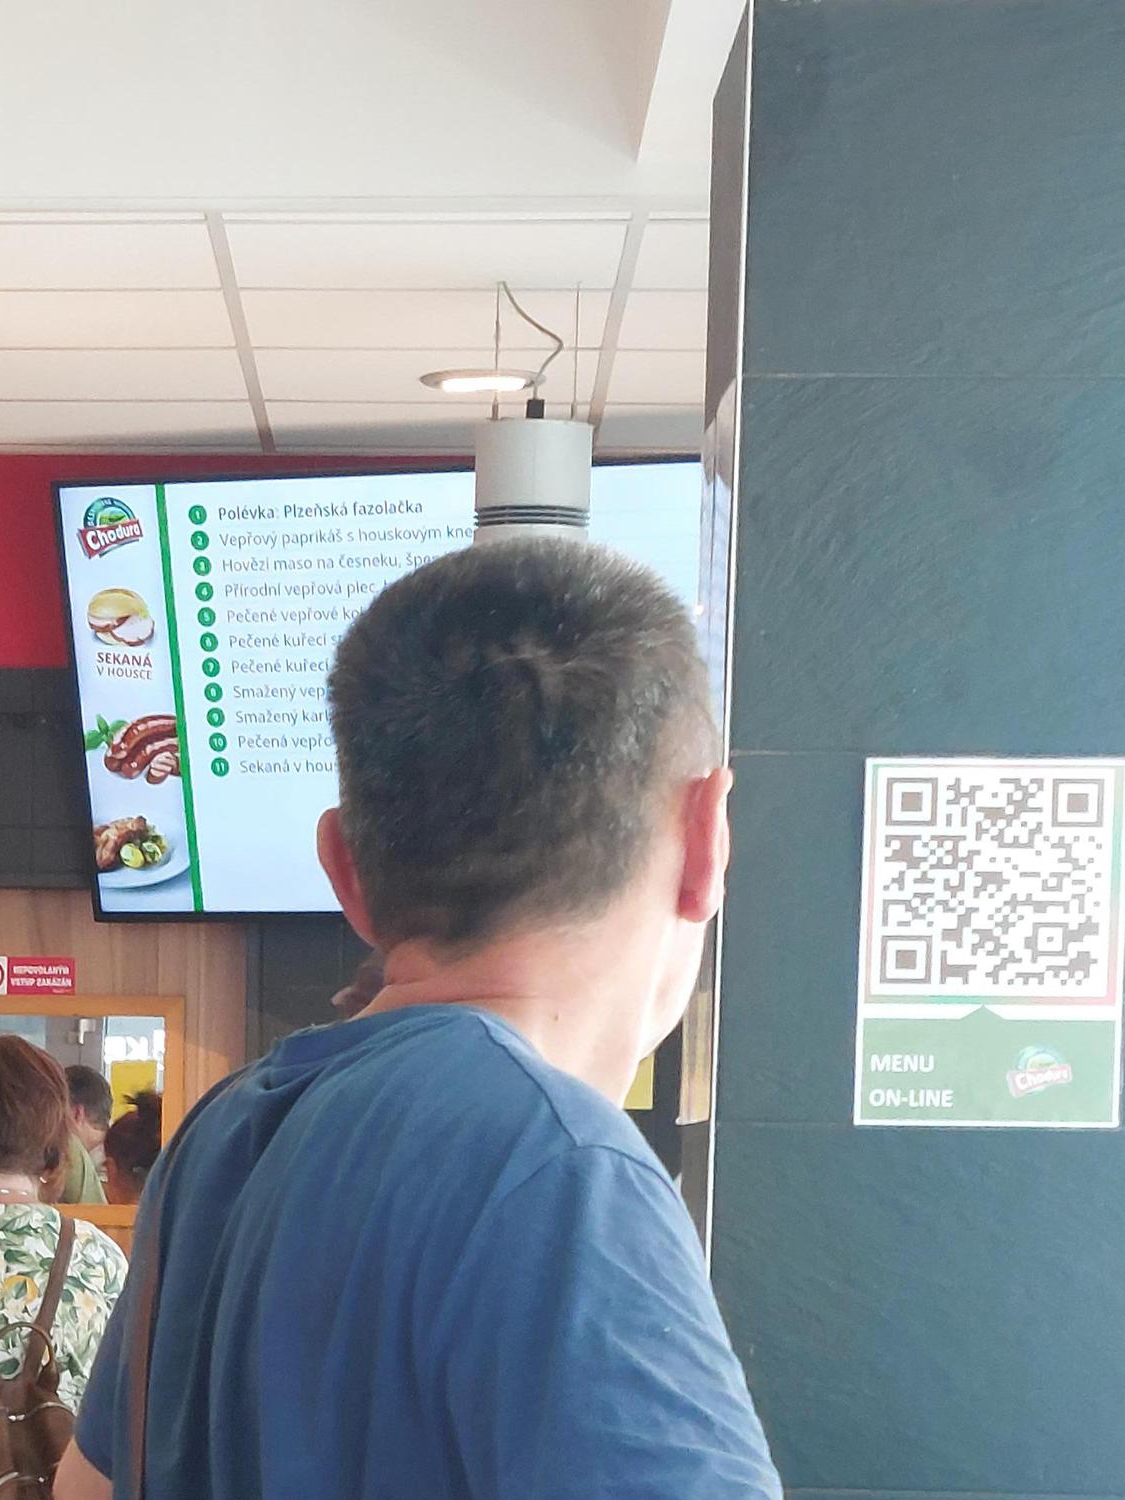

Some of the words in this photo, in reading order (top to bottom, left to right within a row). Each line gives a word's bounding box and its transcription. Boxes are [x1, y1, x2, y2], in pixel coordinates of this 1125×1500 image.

[284, 502, 348, 519] Plzeňská
[353, 500, 423, 517] fazolačka
[86, 522, 141, 550] Chodura
[219, 531, 277, 550] Vepřový
[282, 528, 343, 549] paprikáš
[347, 531, 354, 542] s
[359, 527, 442, 544] houskovým
[446, 525, 473, 539] kne
[222, 556, 270, 572] Hovězí
[274, 558, 313, 571] maso
[317, 557, 335, 569] na
[339, 553, 401, 569] česneku,
[224, 581, 281, 598] Přírodní
[284, 579, 342, 599] vepřová
[227, 607, 277, 623] Pečené
[281, 606, 339, 625] vepřové
[229, 632, 279, 648] Pečené
[284, 631, 326, 647] kuřecí
[96, 651, 153, 668] SEKANÁ
[231, 658, 282, 674] Pečené
[286, 657, 330, 673] kuřecí
[96, 665, 104, 676] V
[107, 666, 152, 680] HOUSCE
[233, 684, 297, 702] Smažený
[299, 686, 330, 701] vep
[235, 709, 299, 727] Smažený
[238, 734, 288, 749] Pečená
[291, 735, 333, 751] vepřo
[240, 759, 290, 774] Sekaná
[294, 761, 302, 772] v
[306, 760, 334, 773] hou
[870, 1053, 935, 1073] MENU
[868, 1087, 954, 1109] ON-LINE
